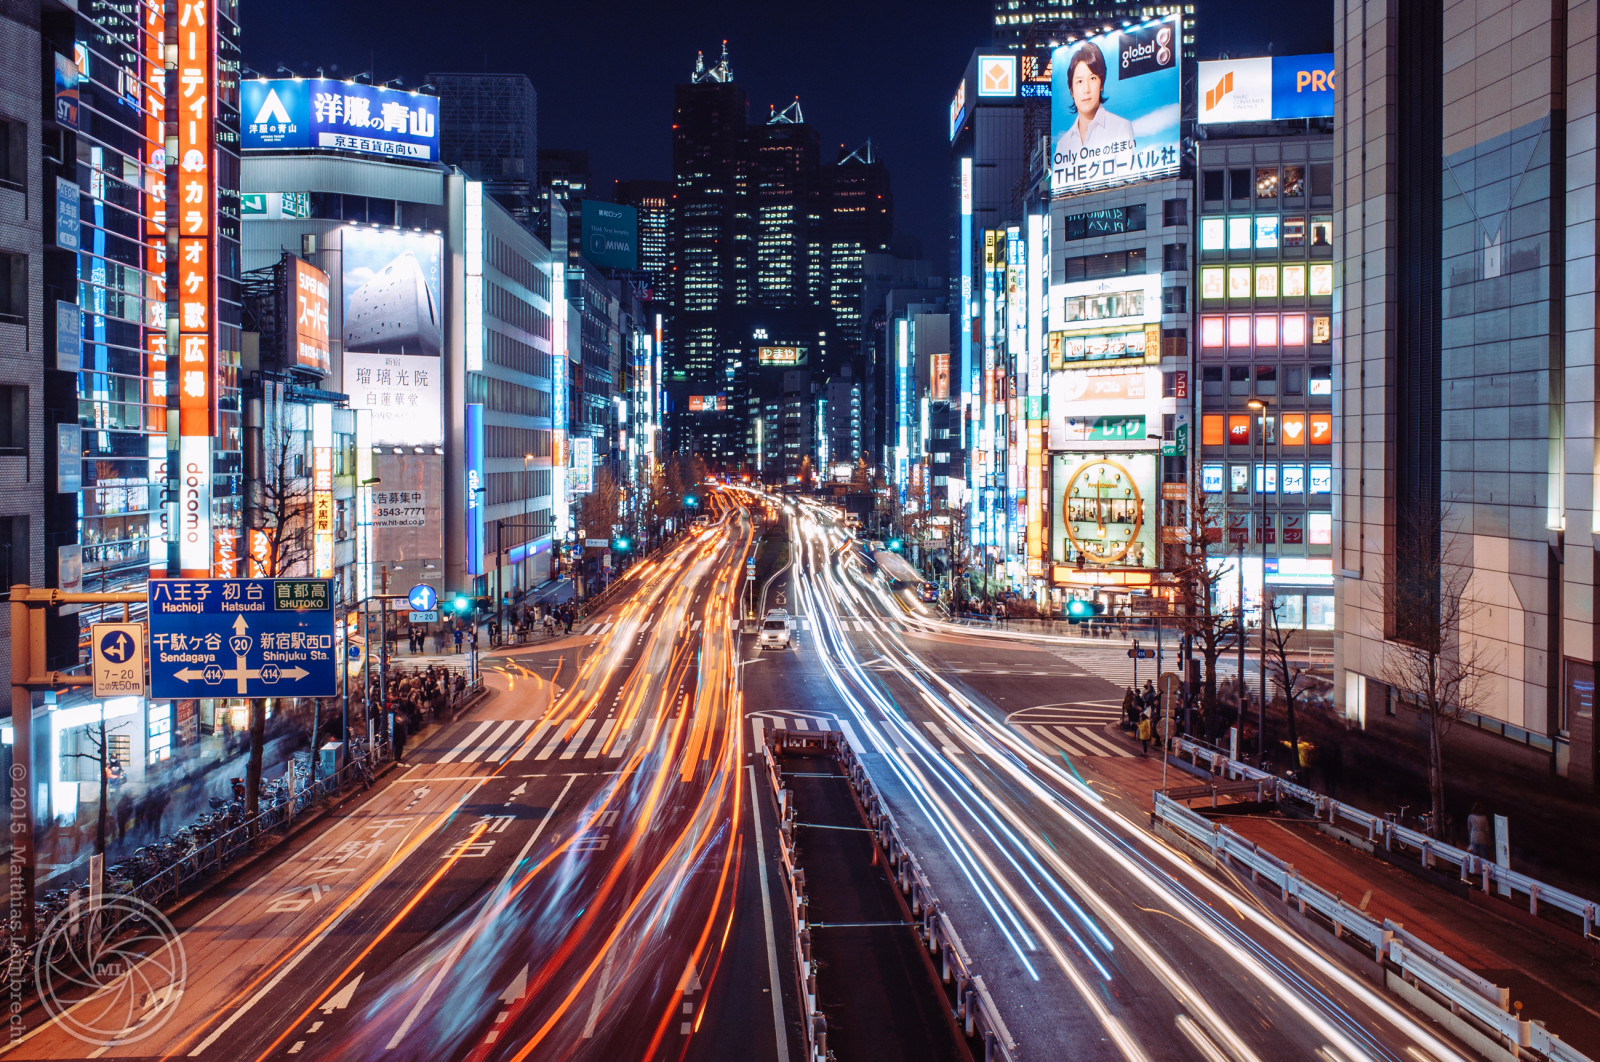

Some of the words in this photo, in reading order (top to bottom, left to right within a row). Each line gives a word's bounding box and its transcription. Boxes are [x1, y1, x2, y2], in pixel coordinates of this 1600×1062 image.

[1121, 41, 1155, 69] global
[314, 92, 435, 137] 洋服の青山
[249, 123, 297, 134] 洋服の青山
[335, 135, 418, 155] 京王百貨店向い
[1054, 150, 1077, 165] Only
[1079, 147, 1101, 160] One
[1102, 139, 1137, 155] の住まい
[1054, 146, 1176, 185] THEグローバル社
[60, 183, 78, 203] AEON
[59, 201, 77, 219] 英会話
[58, 215, 79, 232] イーオン
[605, 240, 630, 252] MIWA
[184, 181, 206, 397] カラオケ歌広場
[299, 271, 317, 295] SUPER
[962, 275, 971, 299] JUST
[1204, 273, 1275, 294] 占い館
[59, 307, 79, 335] 東進
[762, 348, 794, 360] やまや
[1050, 338, 1061, 362] 7F
[385, 358, 401, 367] 新宿
[356, 367, 429, 387] 瑠璃光院
[1177, 373, 1186, 397] アコム
[366, 391, 419, 407] 白蓮華堂
[1102, 418, 1140, 436] レイク
[1231, 425, 1247, 435] 4F
[1177, 430, 1186, 452] レイク
[186, 462, 203, 543] docomo
[318, 499, 329, 530] 大黒屋
[153, 583, 212, 601] 八王子
[222, 582, 264, 600] 初台
[276, 583, 326, 598] 首都高
[162, 602, 204, 614] Hachioji
[221, 602, 265, 612] Hatsudai
[279, 599, 324, 609] SHUTOKO
[234, 639, 248, 651] 20
[260, 632, 331, 650] 新宿駅西口
[160, 652, 216, 664] Sendagaya
[263, 651, 307, 661] Shinjuku
[310, 651, 330, 661] Sta.
[205, 669, 221, 680] 414
[262, 668, 278, 679] 414
[98, 681, 140, 691] この先50m
